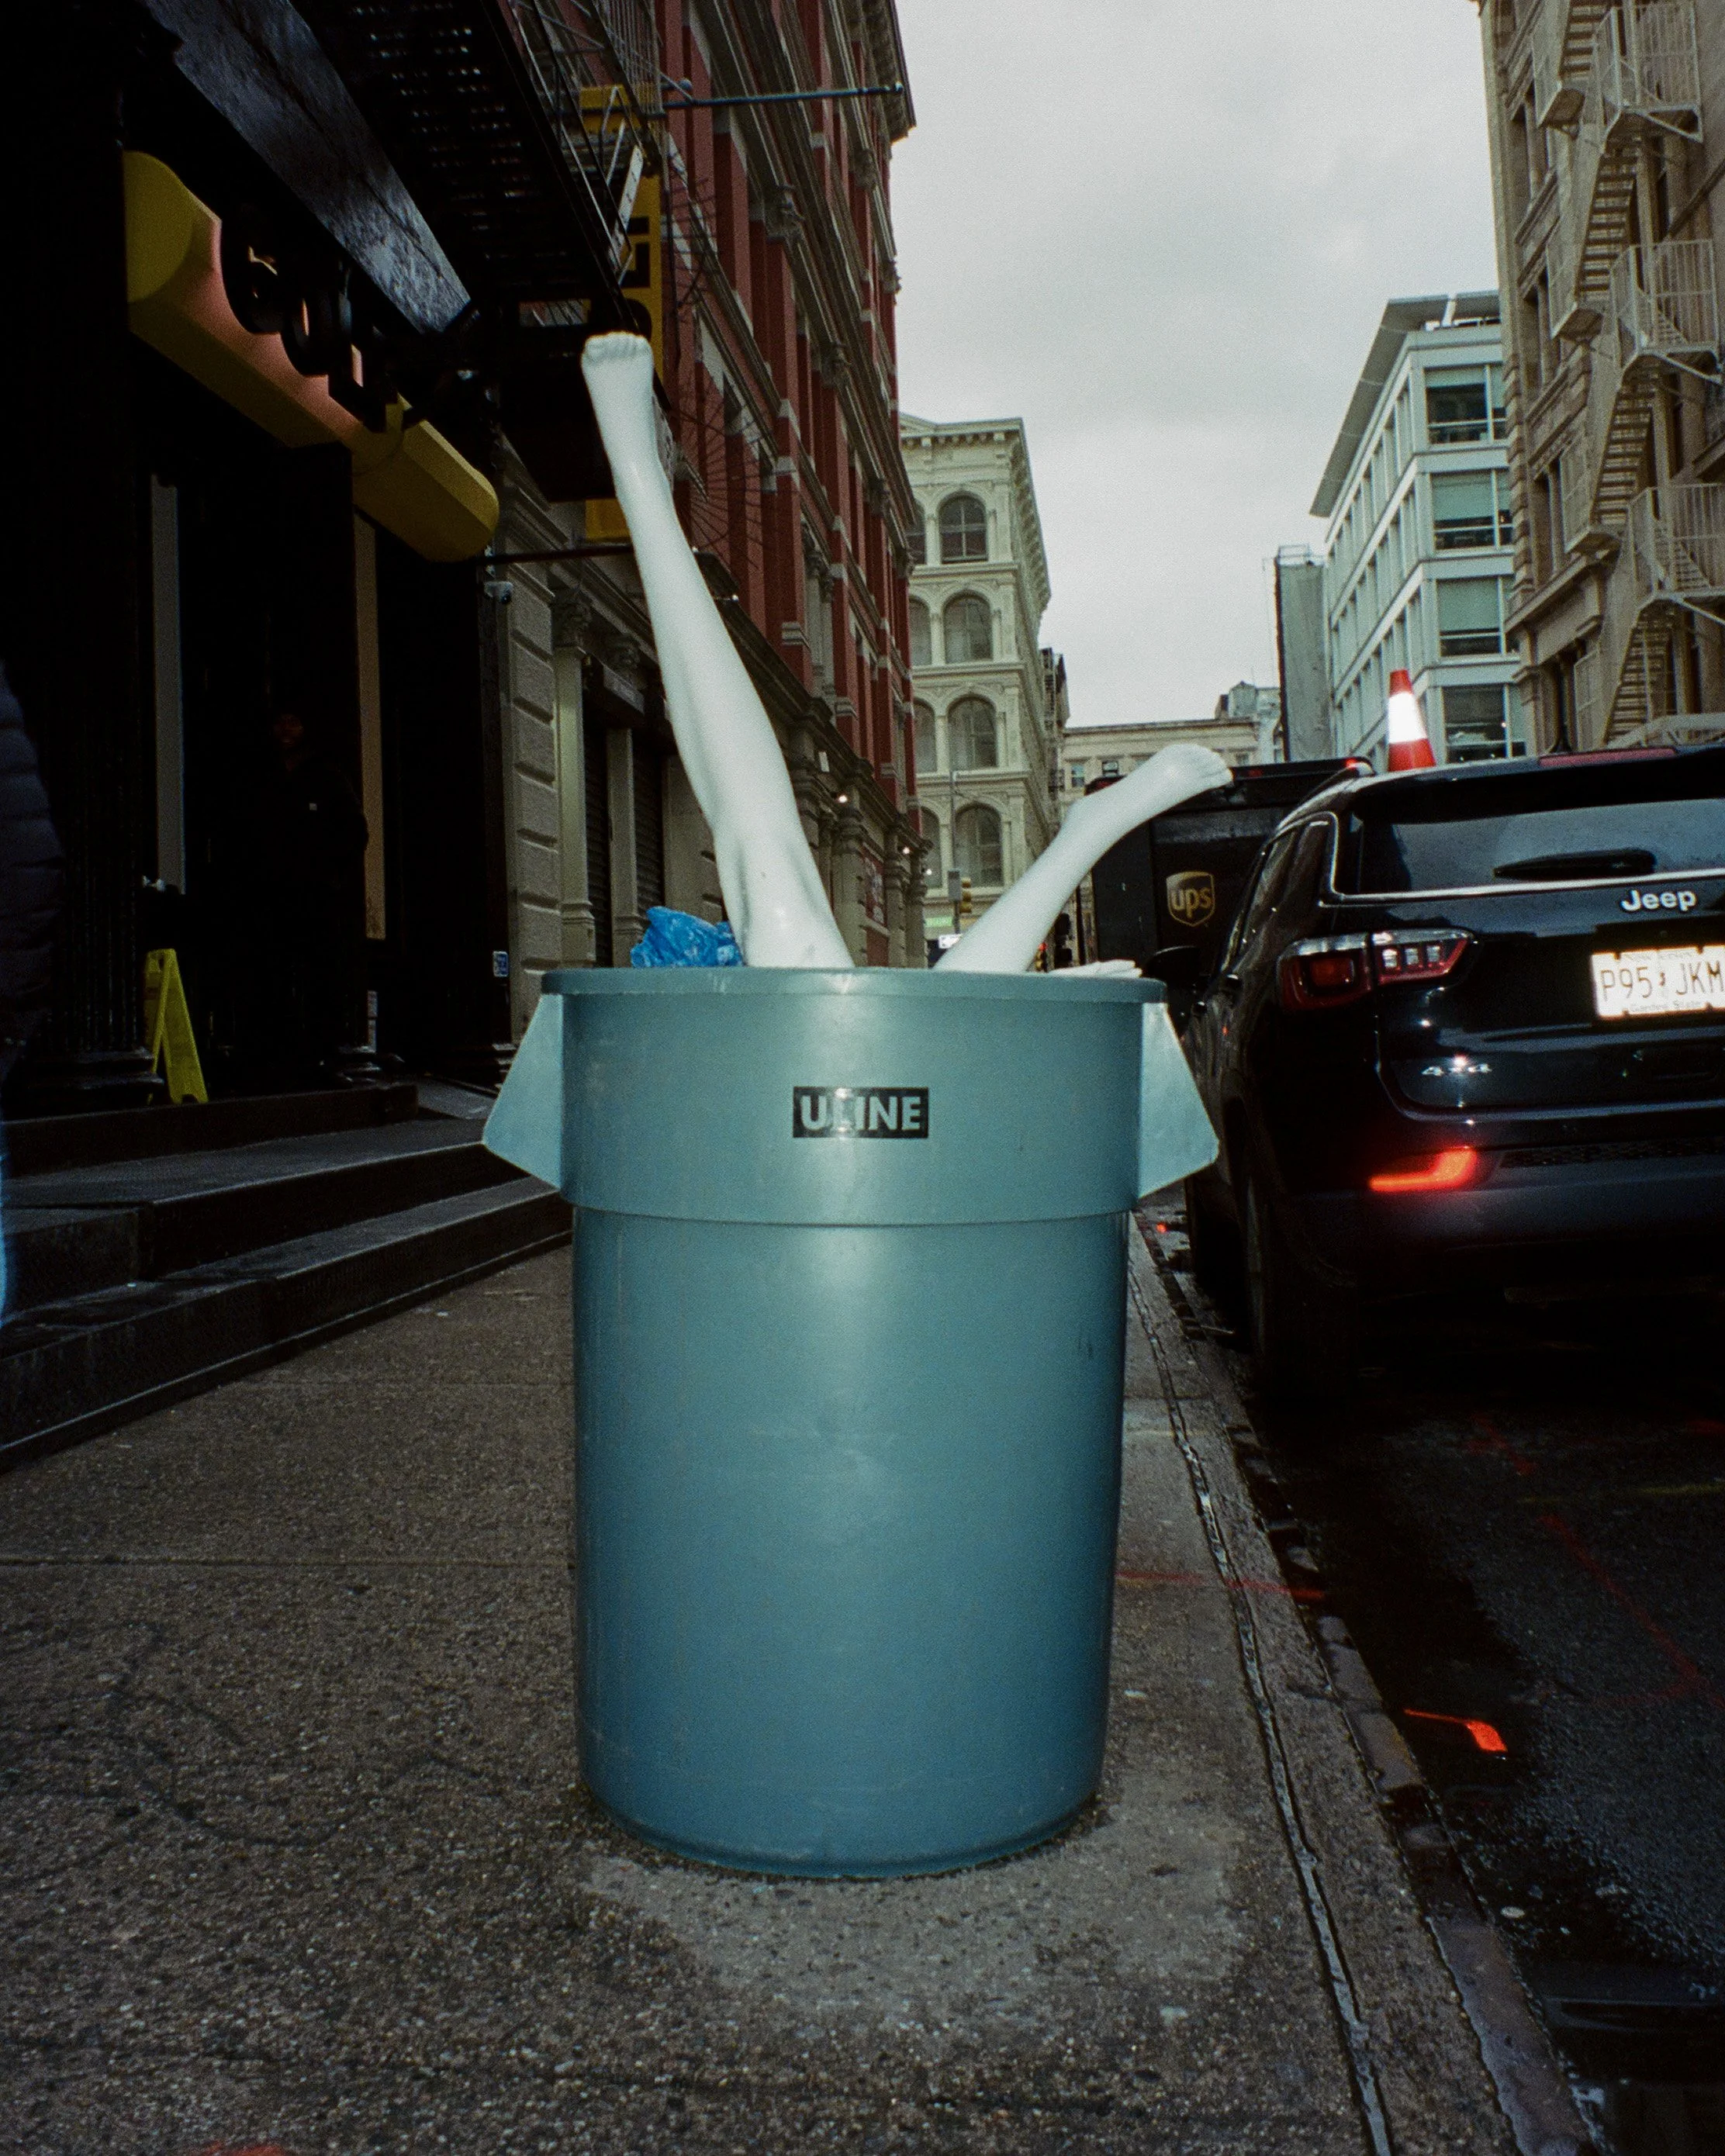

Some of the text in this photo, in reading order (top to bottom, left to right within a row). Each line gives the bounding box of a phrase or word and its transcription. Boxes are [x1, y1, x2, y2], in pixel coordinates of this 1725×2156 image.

[1170, 887, 1213, 918] ups
[1621, 890, 1696, 911] Jeep
[1600, 960, 1724, 1002] P95 JKM
[800, 1094, 921, 1132] ULINE
